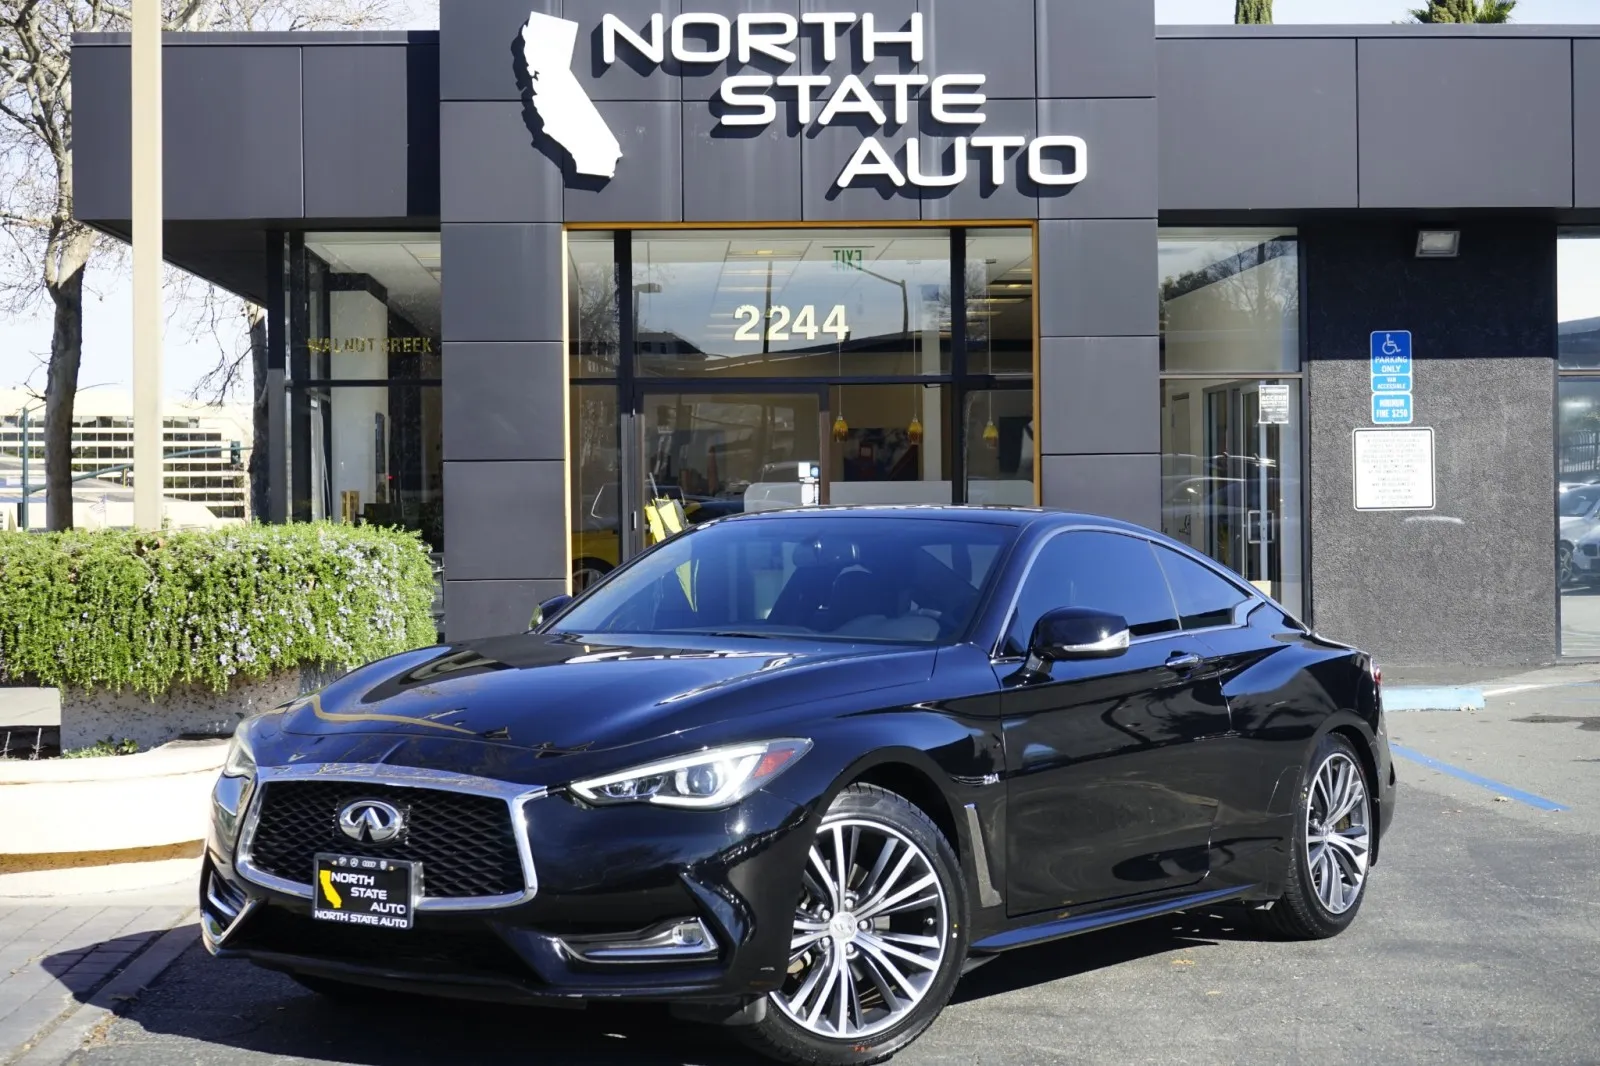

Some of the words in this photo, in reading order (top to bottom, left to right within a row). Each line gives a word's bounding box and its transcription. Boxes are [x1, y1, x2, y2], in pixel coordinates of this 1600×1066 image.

[602, 12, 924, 64] NORTH
[720, 74, 987, 125] STATE
[837, 135, 1088, 188] AUTO
[734, 304, 849, 341] 2244
[381, 337, 433, 353] CREEK
[1381, 364, 1402, 372] ONLY
[1376, 409, 1390, 418] FINE
[1392, 408, 1408, 418] $250
[331, 872, 374, 886] NORTH
[350, 886, 387, 900] STATE
[370, 902, 406, 914] AUTO
[314, 910, 348, 922] NORTH
[350, 914, 378, 924] STATE
[380, 917, 408, 928] AUTO
